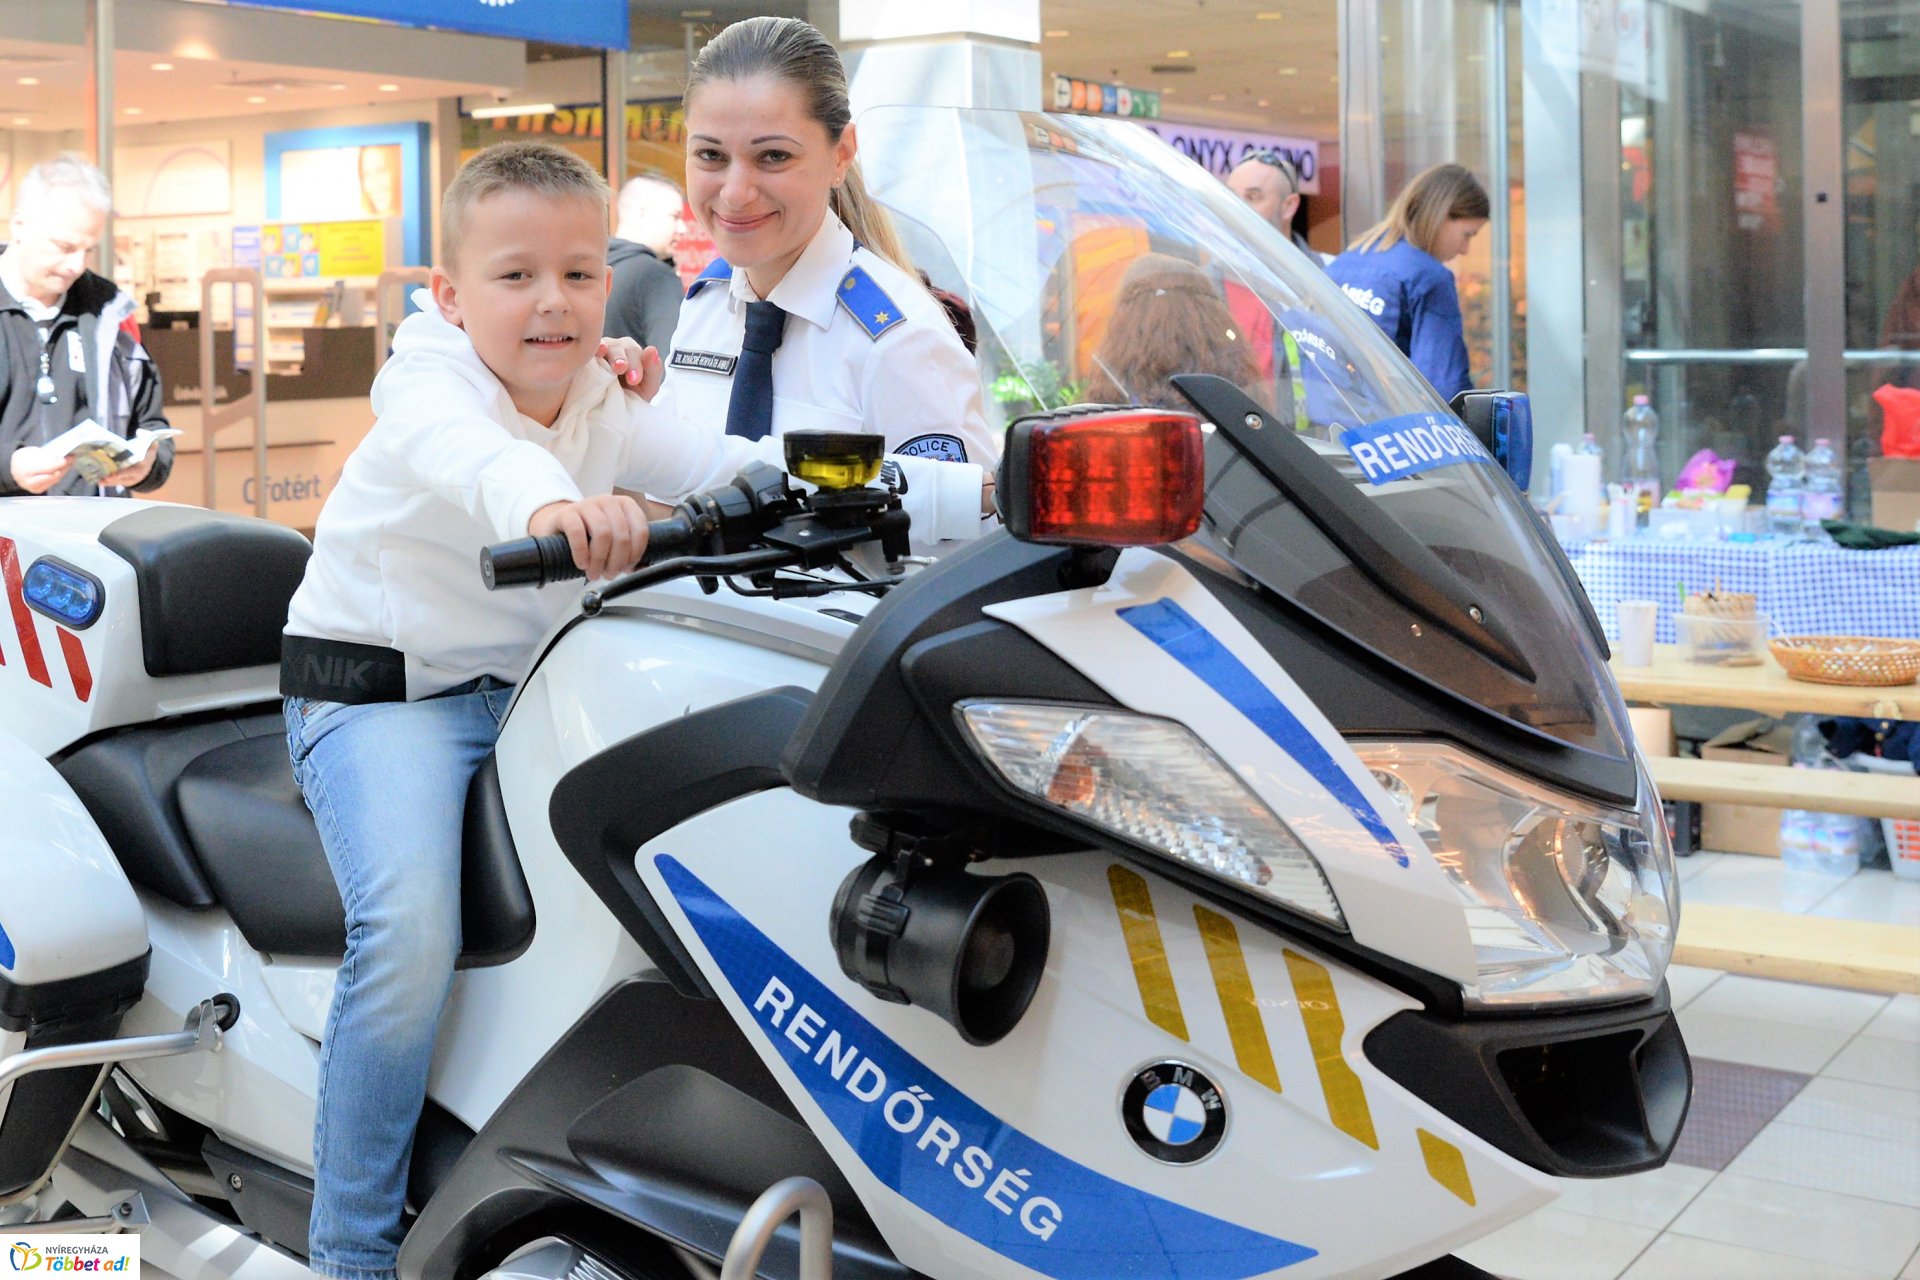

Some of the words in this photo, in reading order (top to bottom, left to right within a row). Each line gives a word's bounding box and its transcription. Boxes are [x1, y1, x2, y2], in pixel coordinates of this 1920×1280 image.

[880, 459, 897, 487] NIK
[302, 653, 390, 690] NIK
[1140, 1066, 1222, 1110] BMW
[753, 975, 1063, 1242] RENDŐRSÉG
